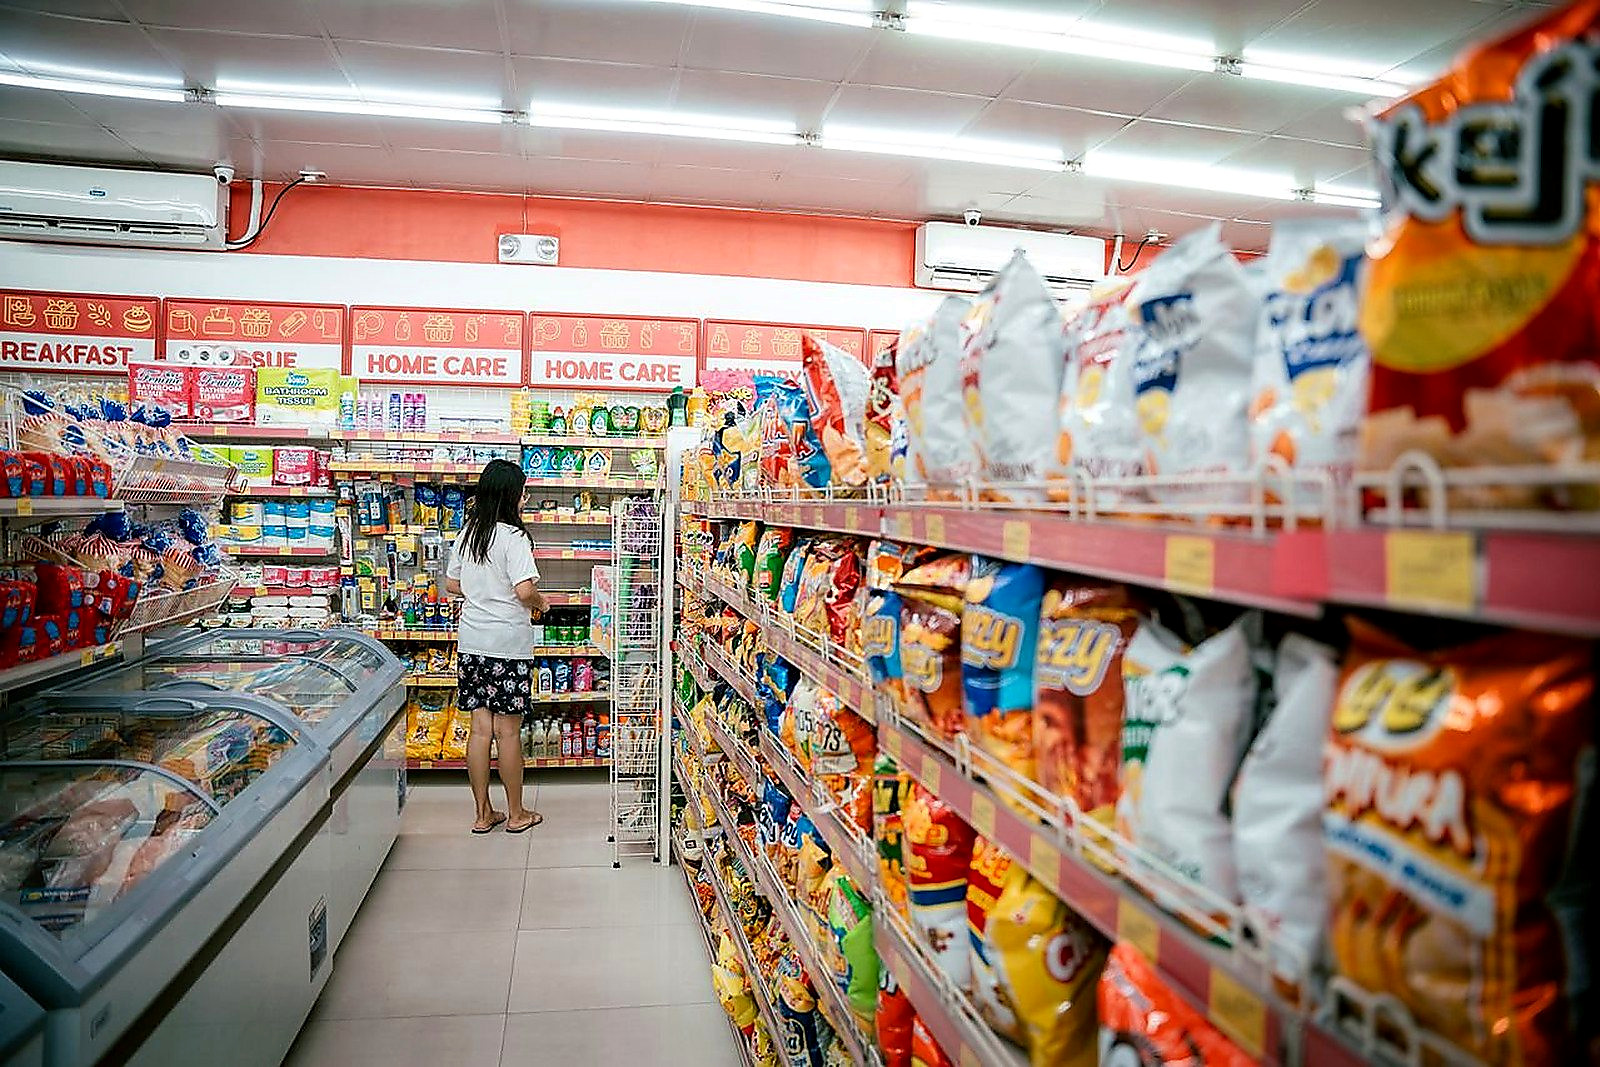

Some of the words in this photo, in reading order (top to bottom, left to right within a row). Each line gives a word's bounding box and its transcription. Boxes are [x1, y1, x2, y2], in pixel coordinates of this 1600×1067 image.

[367, 354, 437, 374] HOME
[443, 356, 507, 377] CARE
[545, 360, 613, 380] HOME
[619, 362, 681, 382] CARE
[136, 384, 182, 393] BATHROOM
[199, 387, 244, 395] BATHROOM
[264, 386, 329, 397] BATHROOM
[276, 396, 316, 406] TISSUE
